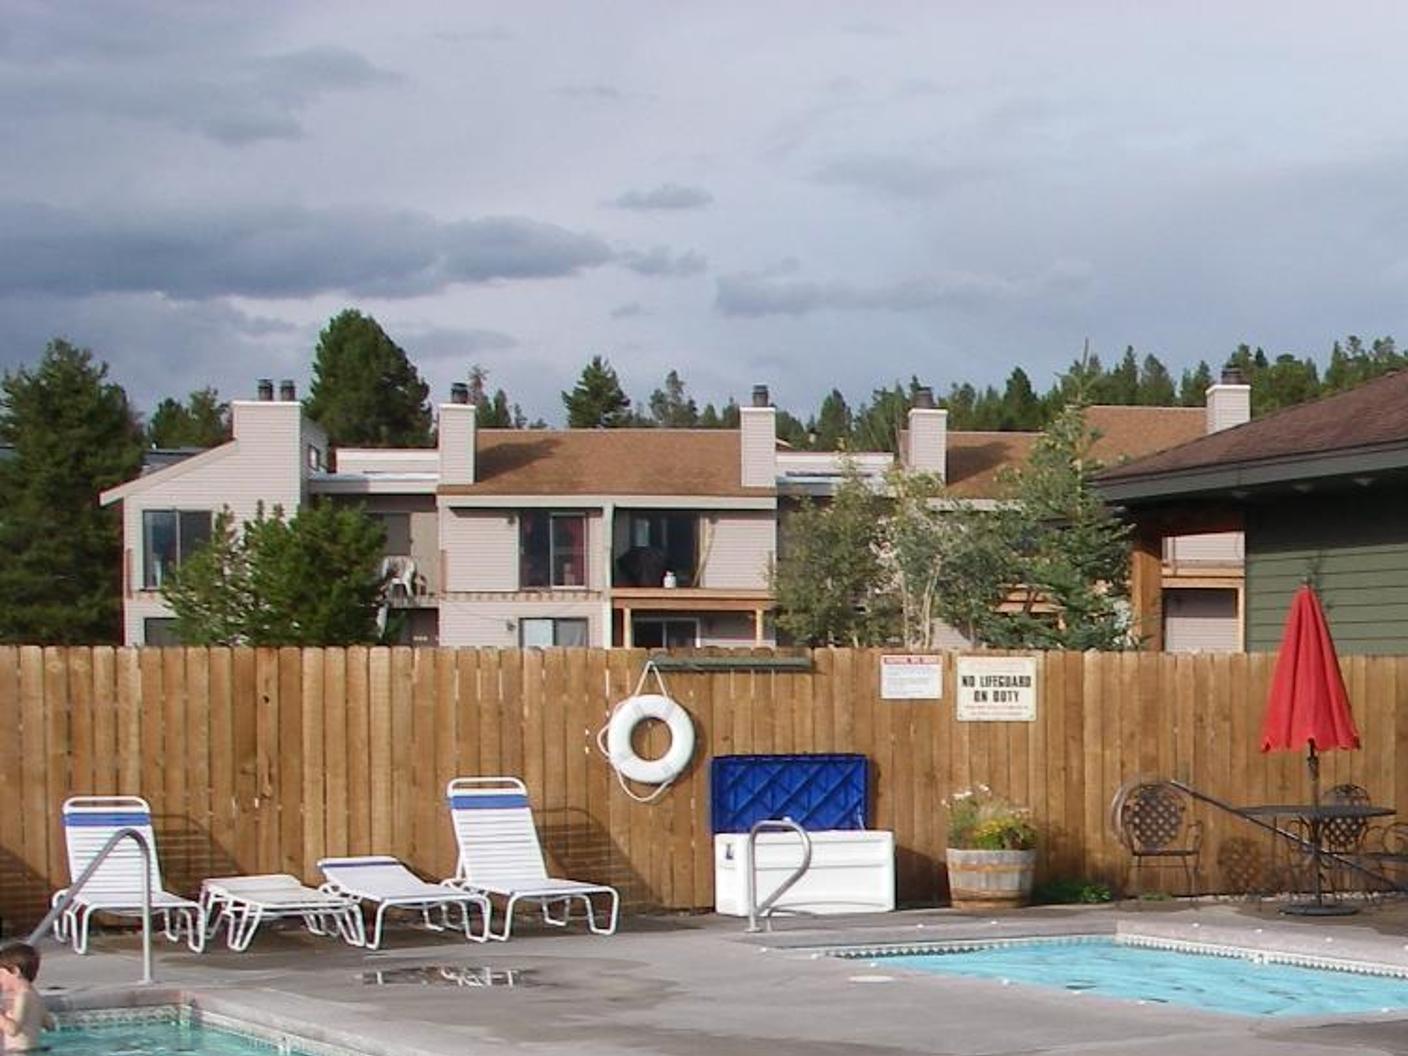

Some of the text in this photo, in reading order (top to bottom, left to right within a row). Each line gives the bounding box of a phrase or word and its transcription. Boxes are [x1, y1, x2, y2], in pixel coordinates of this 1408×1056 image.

[962, 675, 1032, 688] NO LIFEGUARD
[974, 690, 1019, 703] ON DUTY
